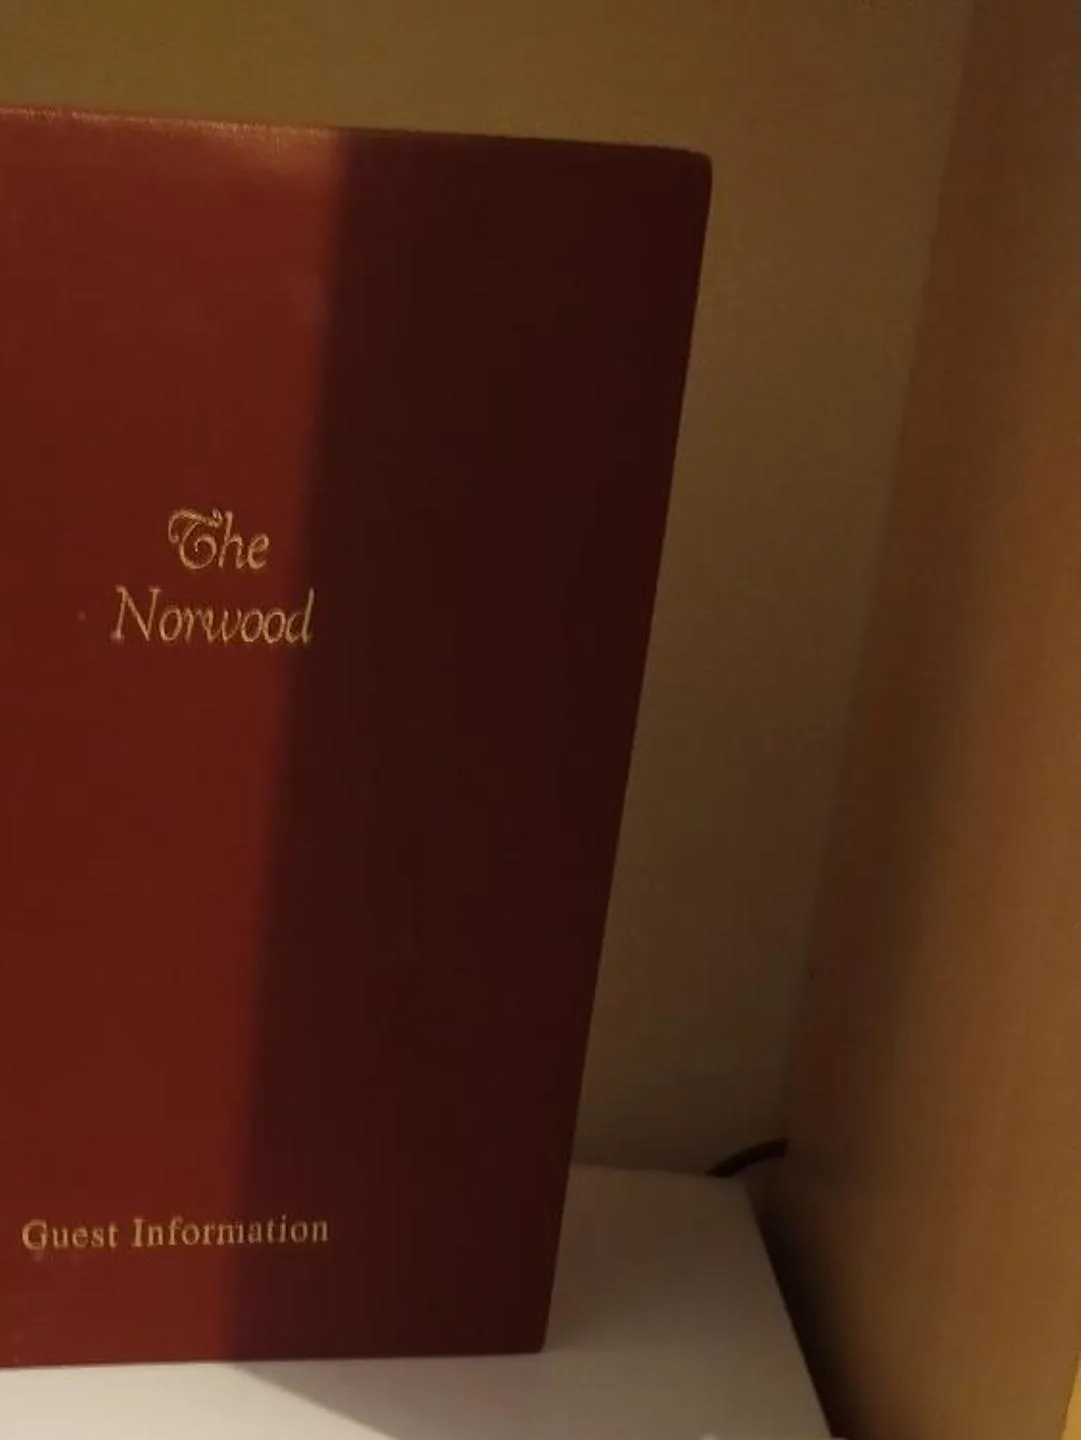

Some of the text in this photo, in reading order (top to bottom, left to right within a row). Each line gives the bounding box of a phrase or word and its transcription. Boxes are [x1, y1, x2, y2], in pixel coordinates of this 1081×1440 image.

[168, 508, 270, 570] The
[110, 585, 315, 643] Norwood
[21, 1214, 329, 1250] Guest Information
